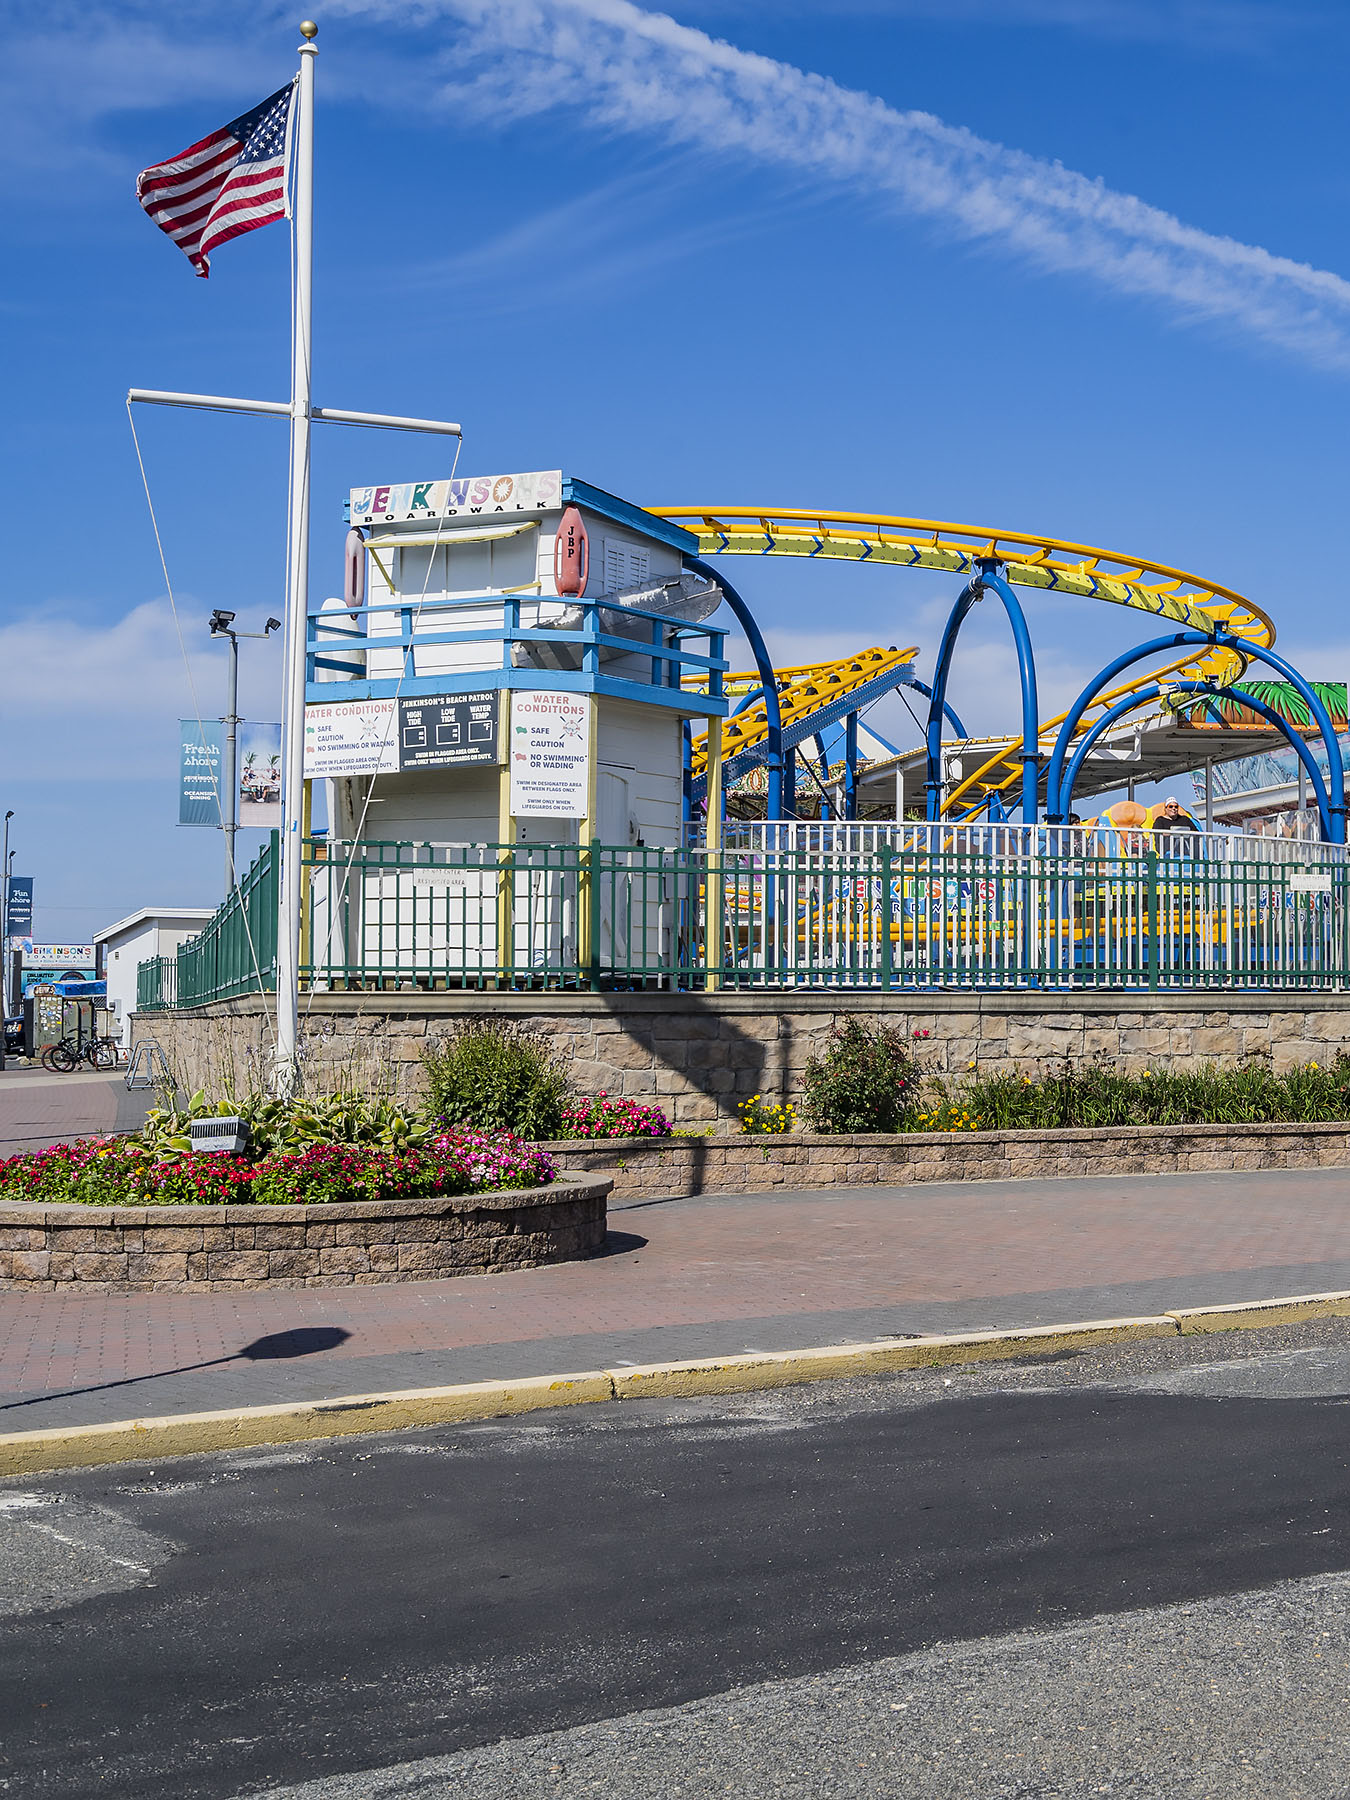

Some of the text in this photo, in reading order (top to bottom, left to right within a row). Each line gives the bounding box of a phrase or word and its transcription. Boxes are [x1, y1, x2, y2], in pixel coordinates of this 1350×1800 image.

[364, 501, 547, 523] BOARDWALK
[446, 696, 468, 704] BEACH
[468, 693, 494, 702] PATROL
[533, 694, 570, 704] WATER
[304, 703, 394, 720] WATER CONDITIONS
[440, 708, 456, 716] LOW
[470, 704, 492, 712] WATER
[516, 704, 585, 715] CONDITIONS
[406, 710, 422, 719] HIGH
[440, 715, 456, 723] TIDE
[472, 712, 490, 720] TEMP
[182, 744, 220, 754] Fresh
[328, 742, 360, 751] SWIMMING
[370, 740, 394, 748] WADING
[530, 740, 565, 748] CAUTION
[184, 756, 218, 766] shore
[544, 754, 584, 762] SWIMMING
